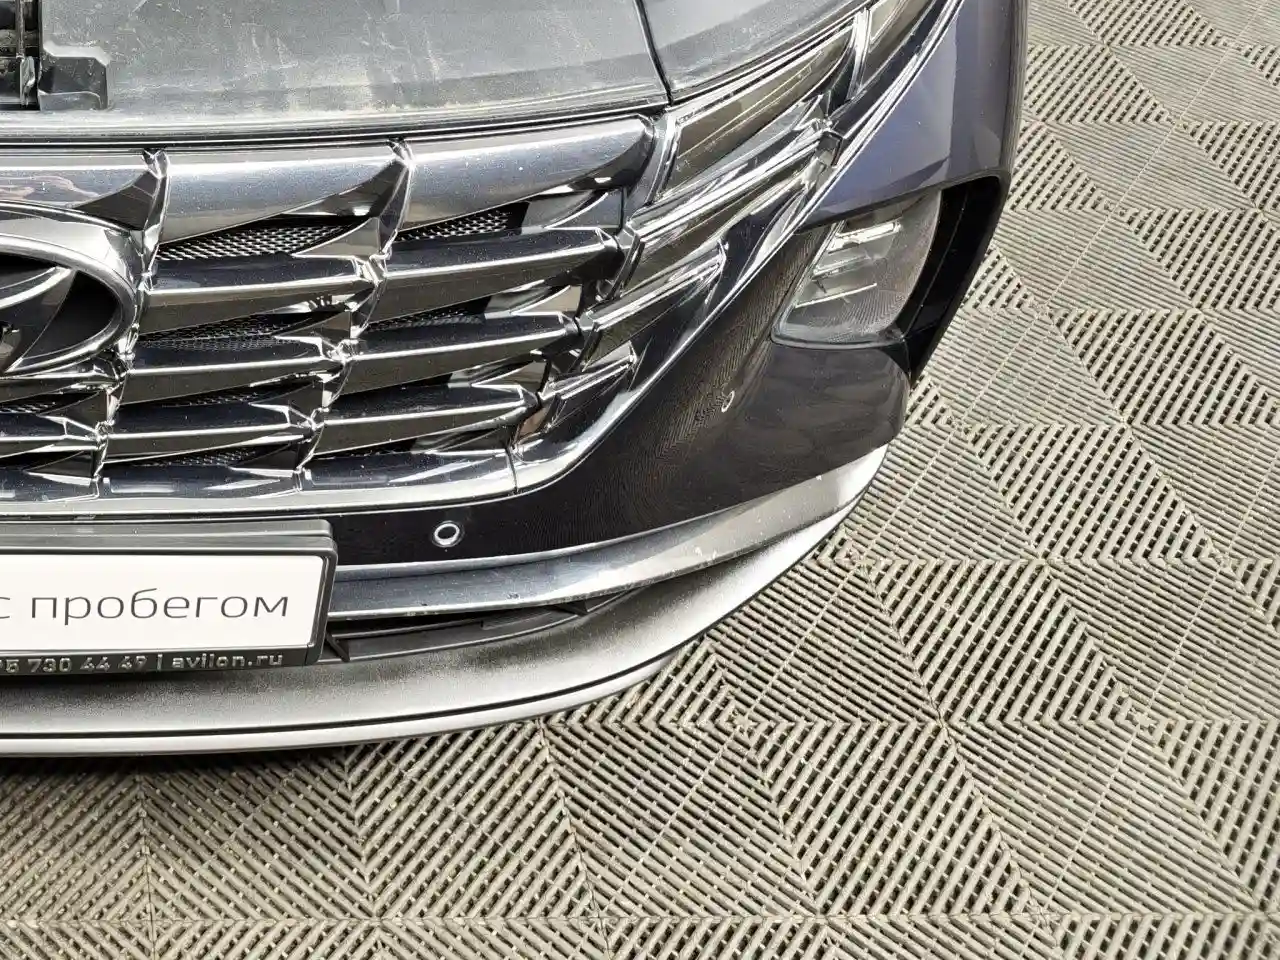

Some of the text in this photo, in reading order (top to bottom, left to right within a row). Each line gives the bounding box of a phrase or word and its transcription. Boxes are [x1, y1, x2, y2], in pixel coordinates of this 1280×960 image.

[30, 587, 290, 626] пробегом
[27, 657, 72, 674] 730
[79, 656, 112, 672] 44
[171, 651, 283, 669] avilon.ru
